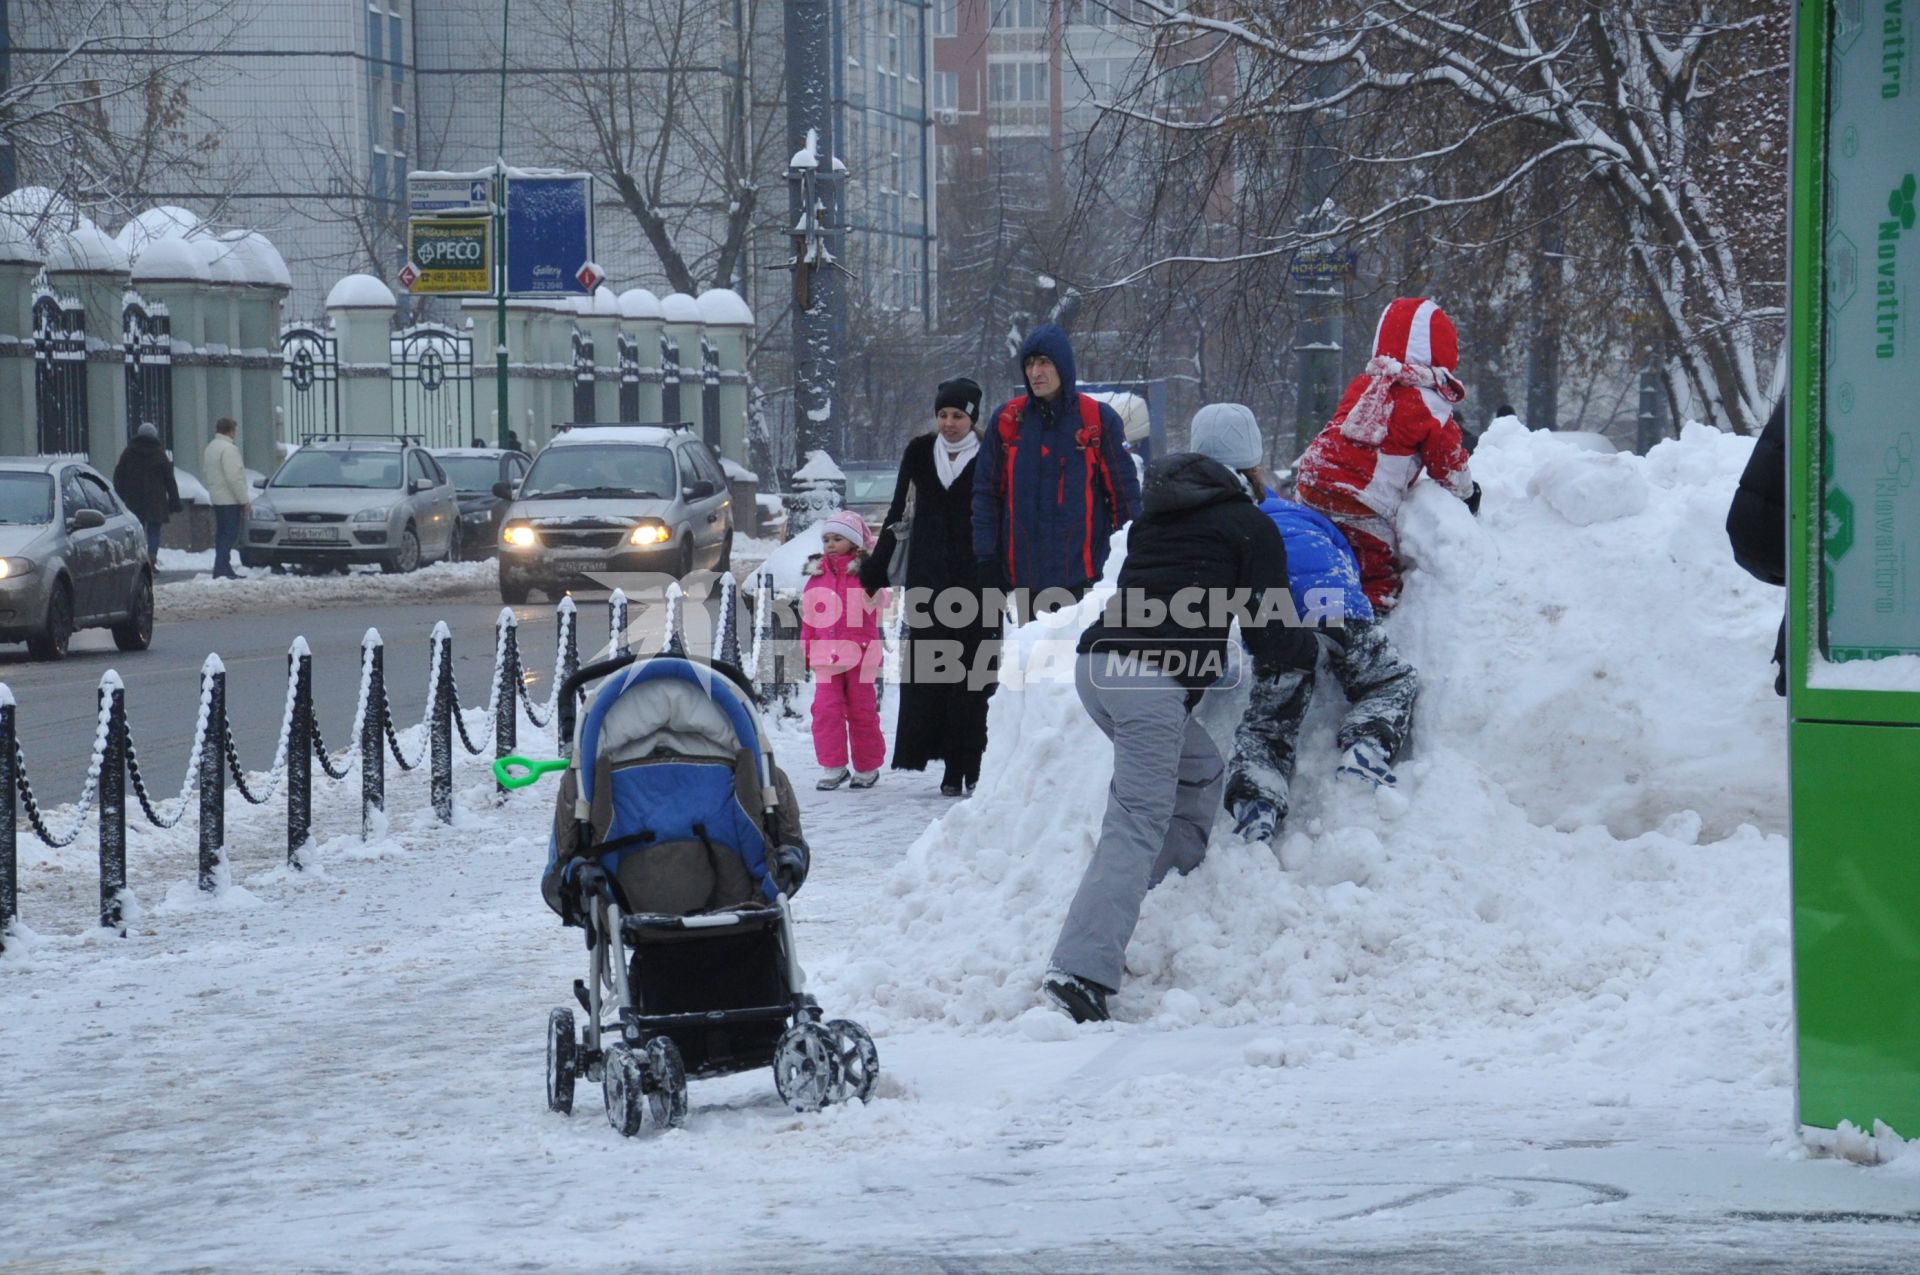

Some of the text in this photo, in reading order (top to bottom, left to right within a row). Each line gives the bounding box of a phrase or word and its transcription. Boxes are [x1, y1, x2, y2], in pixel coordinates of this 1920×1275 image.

[532, 264, 562, 280] Gallery
[1876, 221, 1900, 358] Novattro
[1876, 479, 1897, 613] Novattro
